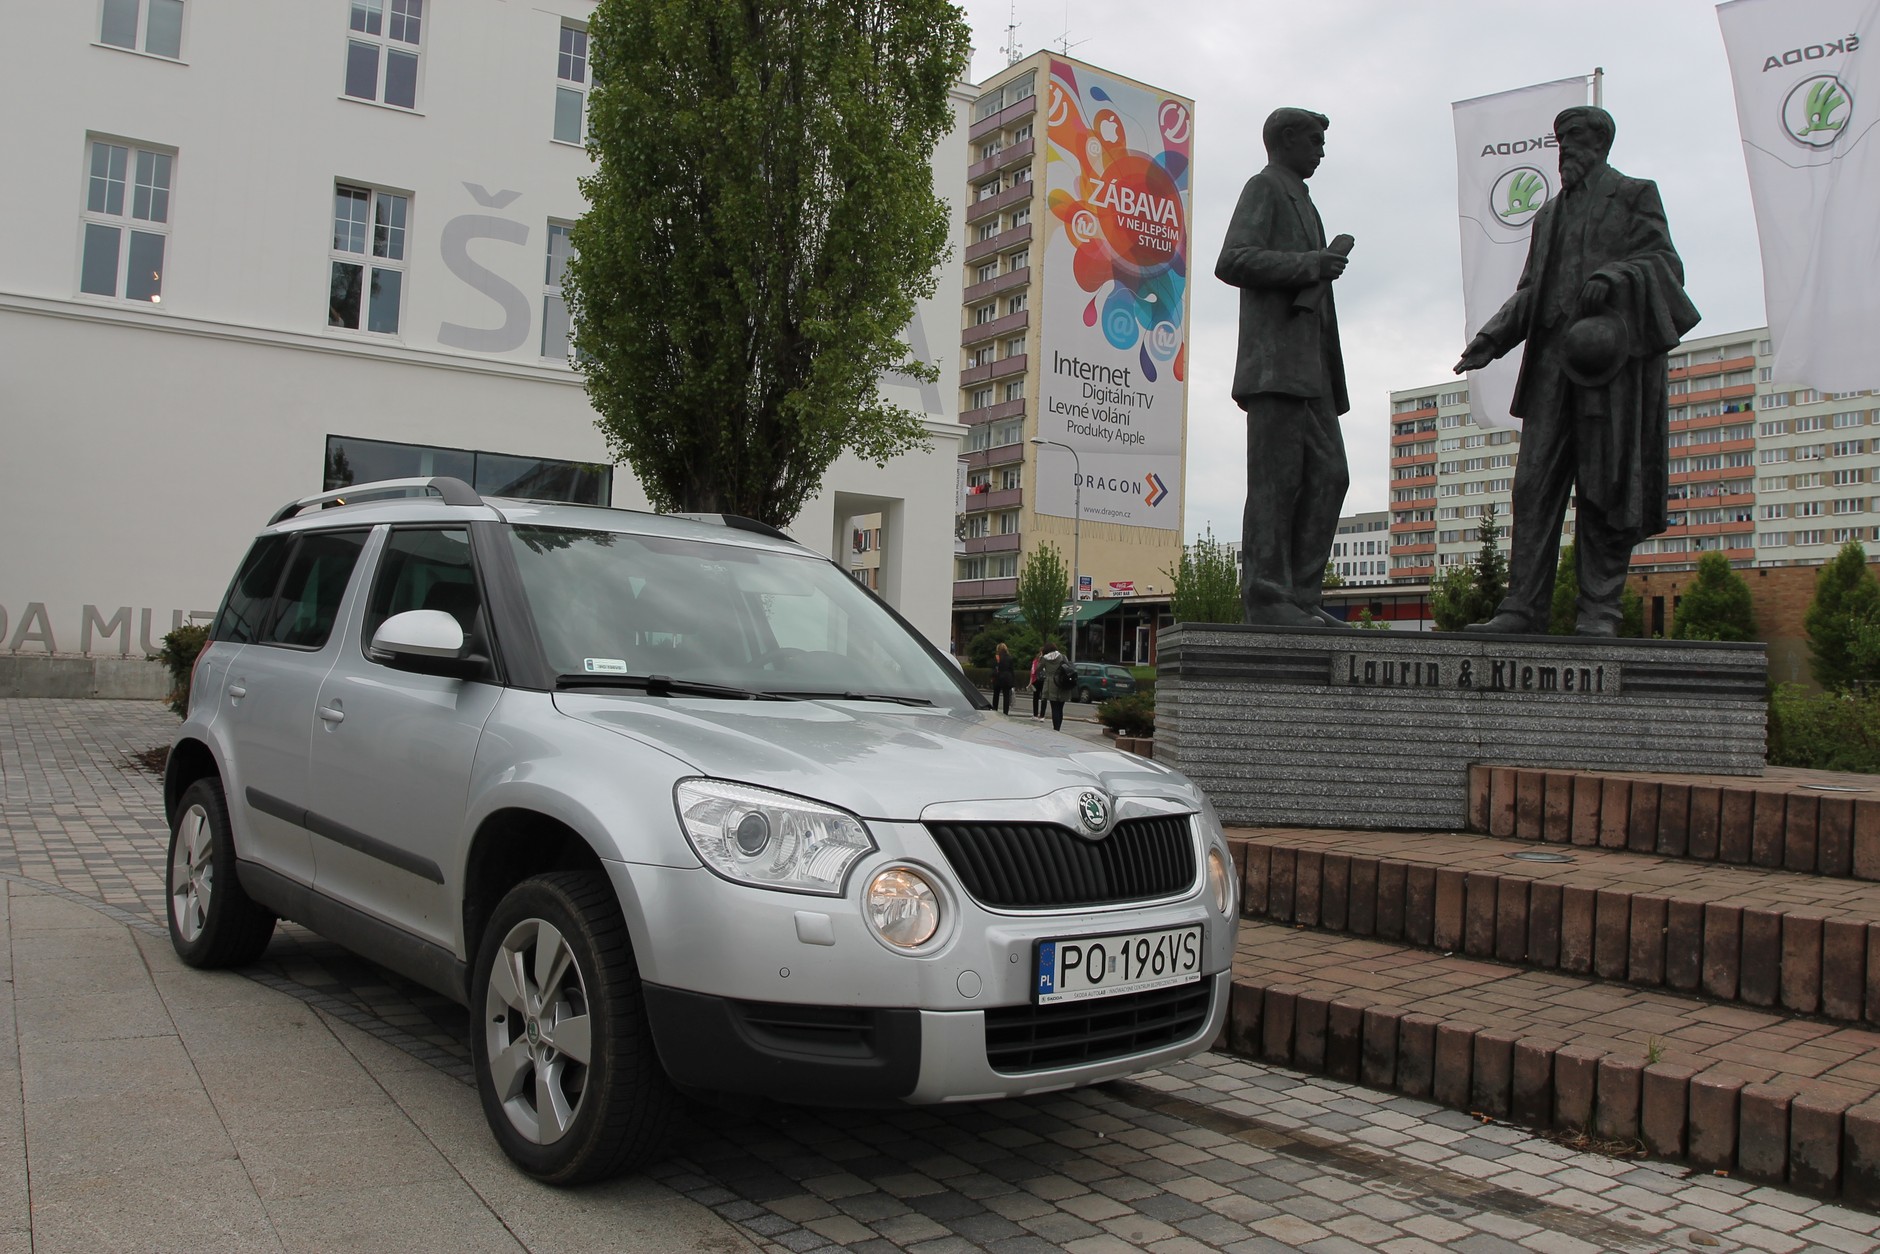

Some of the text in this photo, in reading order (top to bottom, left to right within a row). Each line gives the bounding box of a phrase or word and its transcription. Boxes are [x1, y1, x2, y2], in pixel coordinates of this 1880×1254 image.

[1088, 178, 1179, 227] ZÁBAVA
[1117, 215, 1179, 240] V NEJLEPŠÍM
[1139, 235, 1172, 252] STYLU!
[1054, 350, 1131, 388] Internet
[1082, 382, 1154, 409] Digitální TV
[1049, 396, 1131, 426] Levné volání
[1067, 420, 1145, 446] Produkty Apple
[1074, 473, 1140, 495] DRAGON
[1084, 506, 1131, 518] www.dragon.cz
[1349, 654, 1605, 692] Laurin & Klement
[1060, 932, 1197, 988] PO 196VS
[1040, 974, 1052, 987] PL
